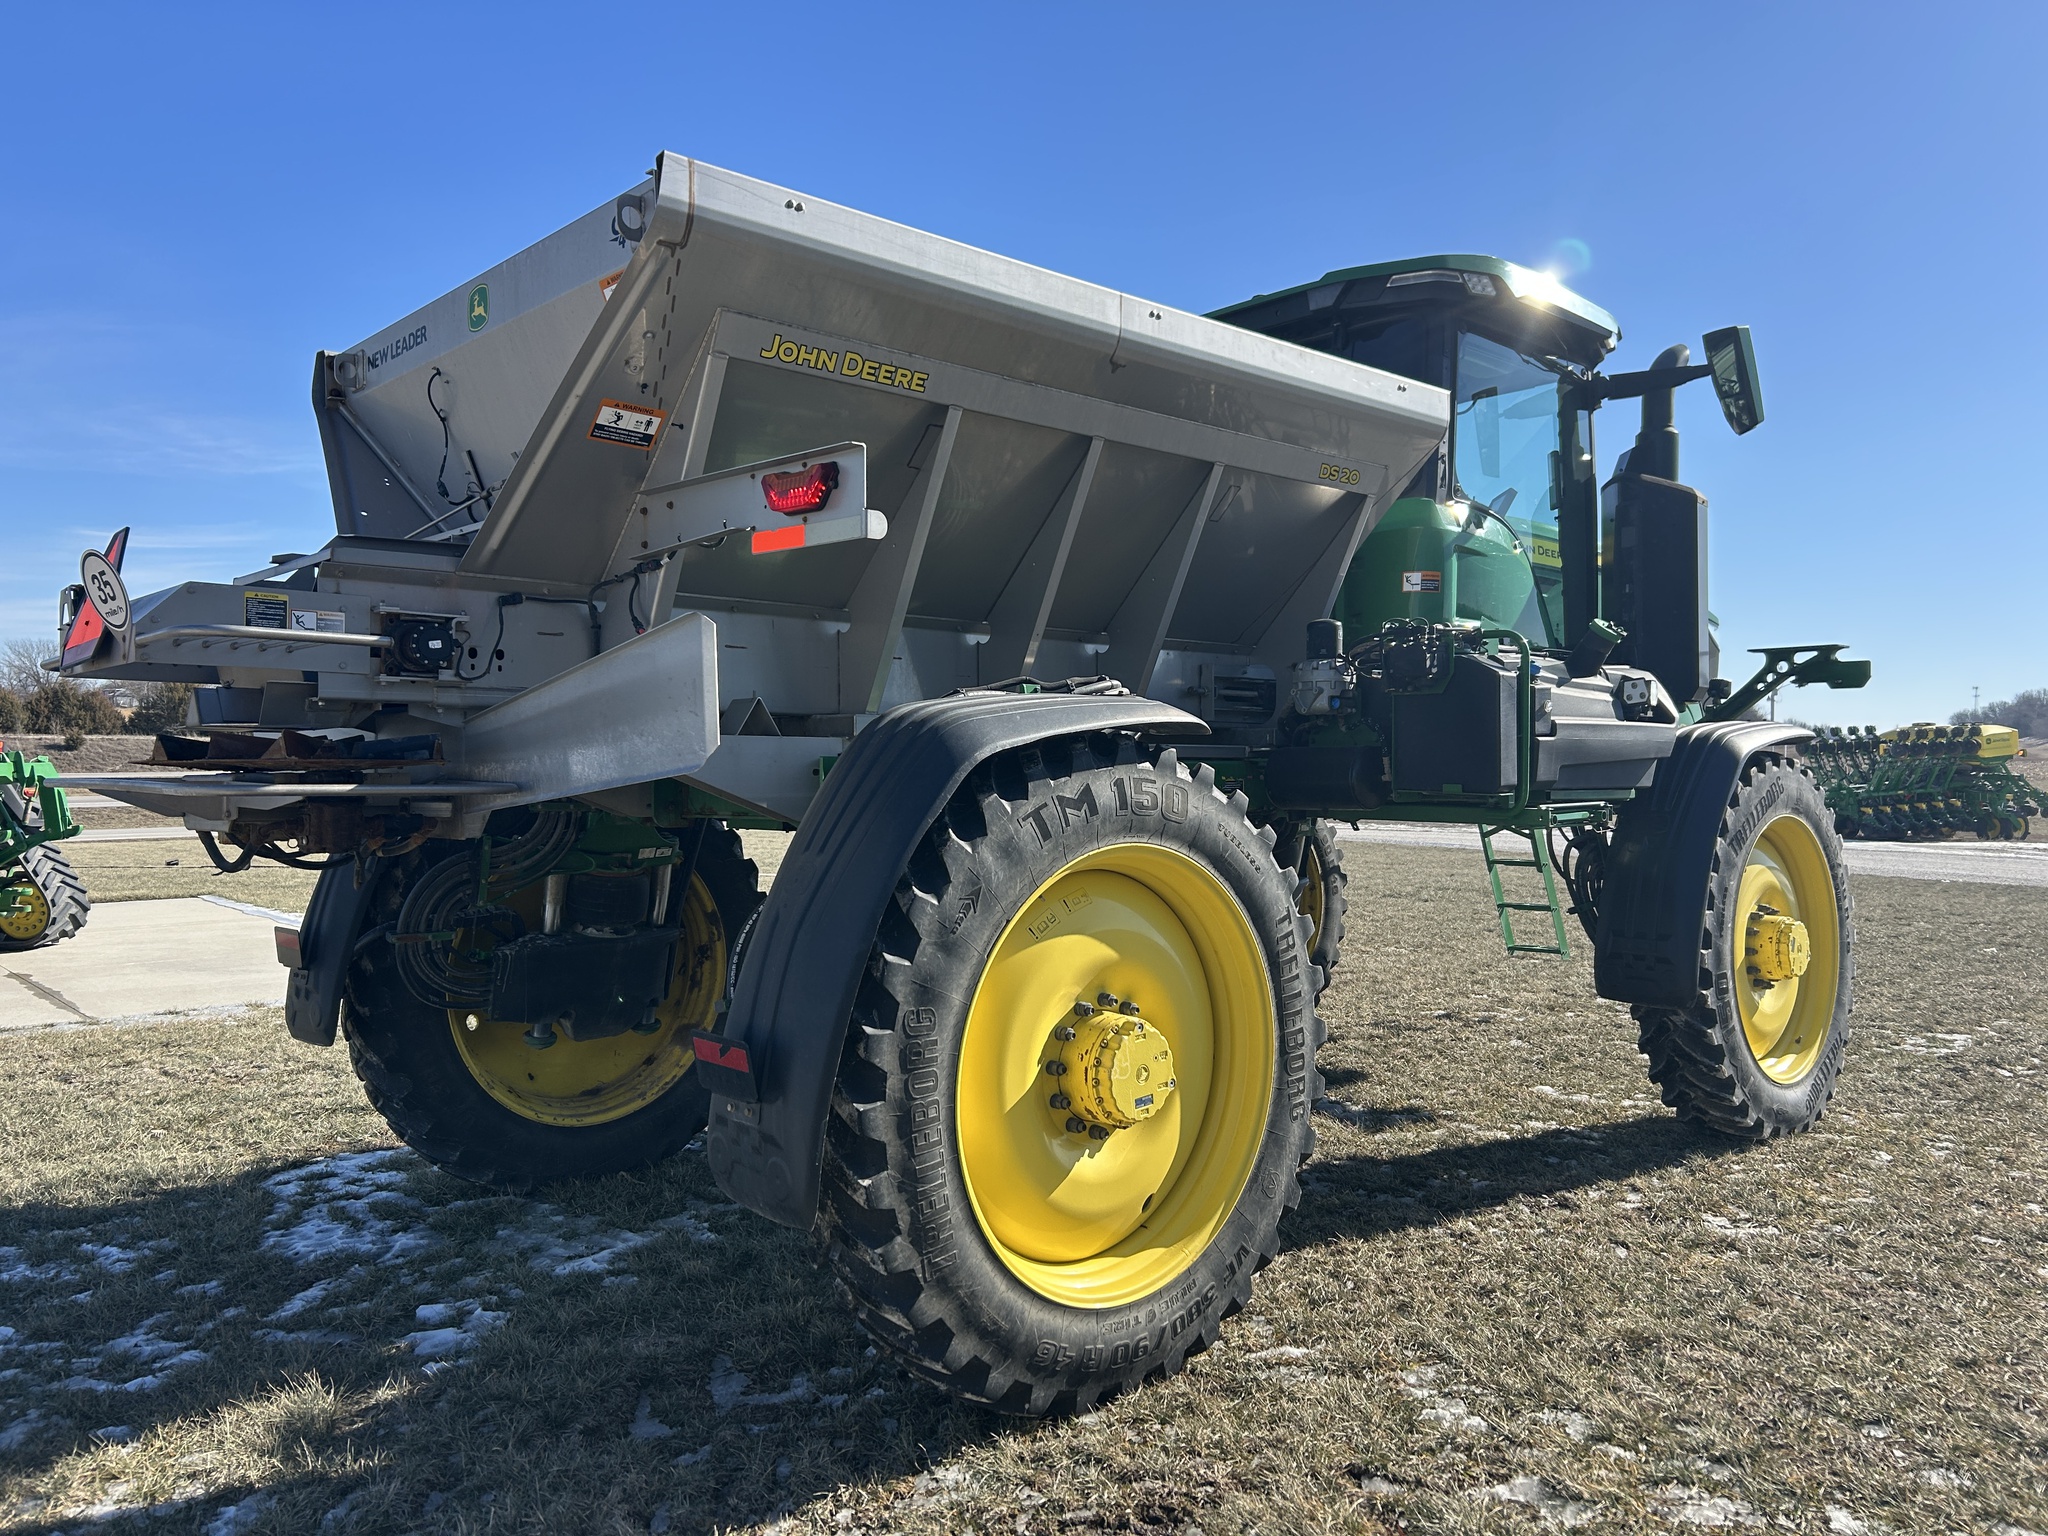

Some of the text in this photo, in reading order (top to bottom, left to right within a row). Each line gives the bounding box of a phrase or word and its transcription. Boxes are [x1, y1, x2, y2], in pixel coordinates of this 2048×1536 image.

[367, 325, 428, 373] NEW LEADER
[760, 333, 930, 393] JOHN DEERE
[622, 403, 655, 415] WARNING
[91, 569, 117, 605] 35
[105, 604, 125, 619] mile/h
[1017, 775, 1190, 850] TM 150
[1728, 776, 1786, 858] TRELLEBORG
[1273, 905, 1307, 1125] TRELLEBORG
[901, 1006, 961, 1285] TRELLEBORG
[1223, 1244, 1251, 1290] VF
[1033, 1338, 1076, 1372] 46
